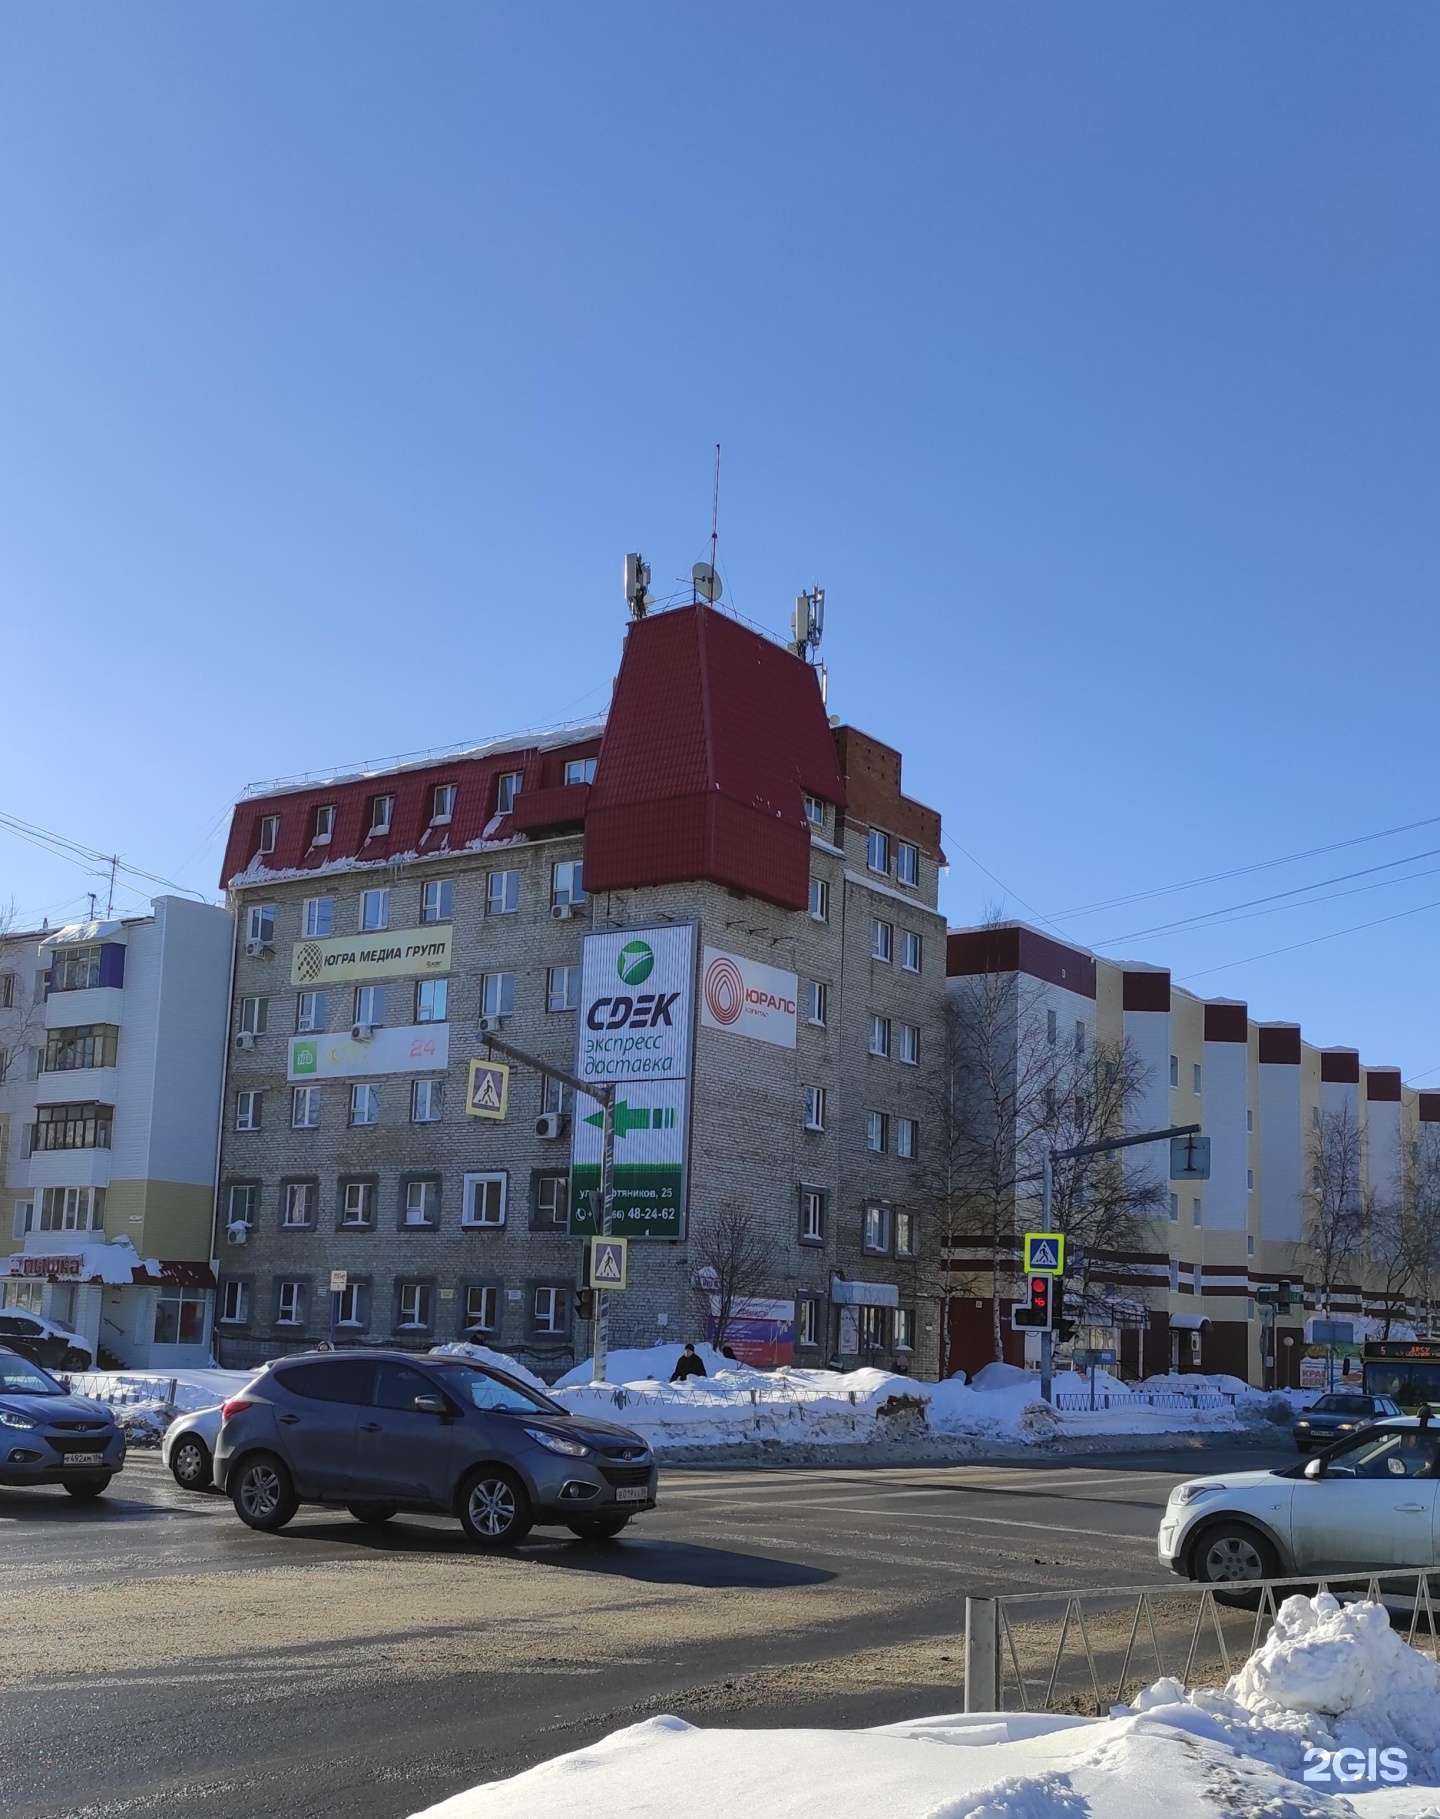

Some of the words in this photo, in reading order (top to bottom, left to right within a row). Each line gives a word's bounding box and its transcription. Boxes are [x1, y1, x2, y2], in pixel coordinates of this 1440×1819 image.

[323, 952, 355, 967] ЮГРА
[359, 947, 401, 963] МЕДИА
[405, 942, 446, 957] ГРУПП
[587, 992, 680, 1031] CDEK
[745, 988, 796, 1014] ЮРАЛС
[585, 1035, 663, 1056] экспресс
[584, 1056, 673, 1075] доставка
[627, 1207, 676, 1219] 48-24-62
